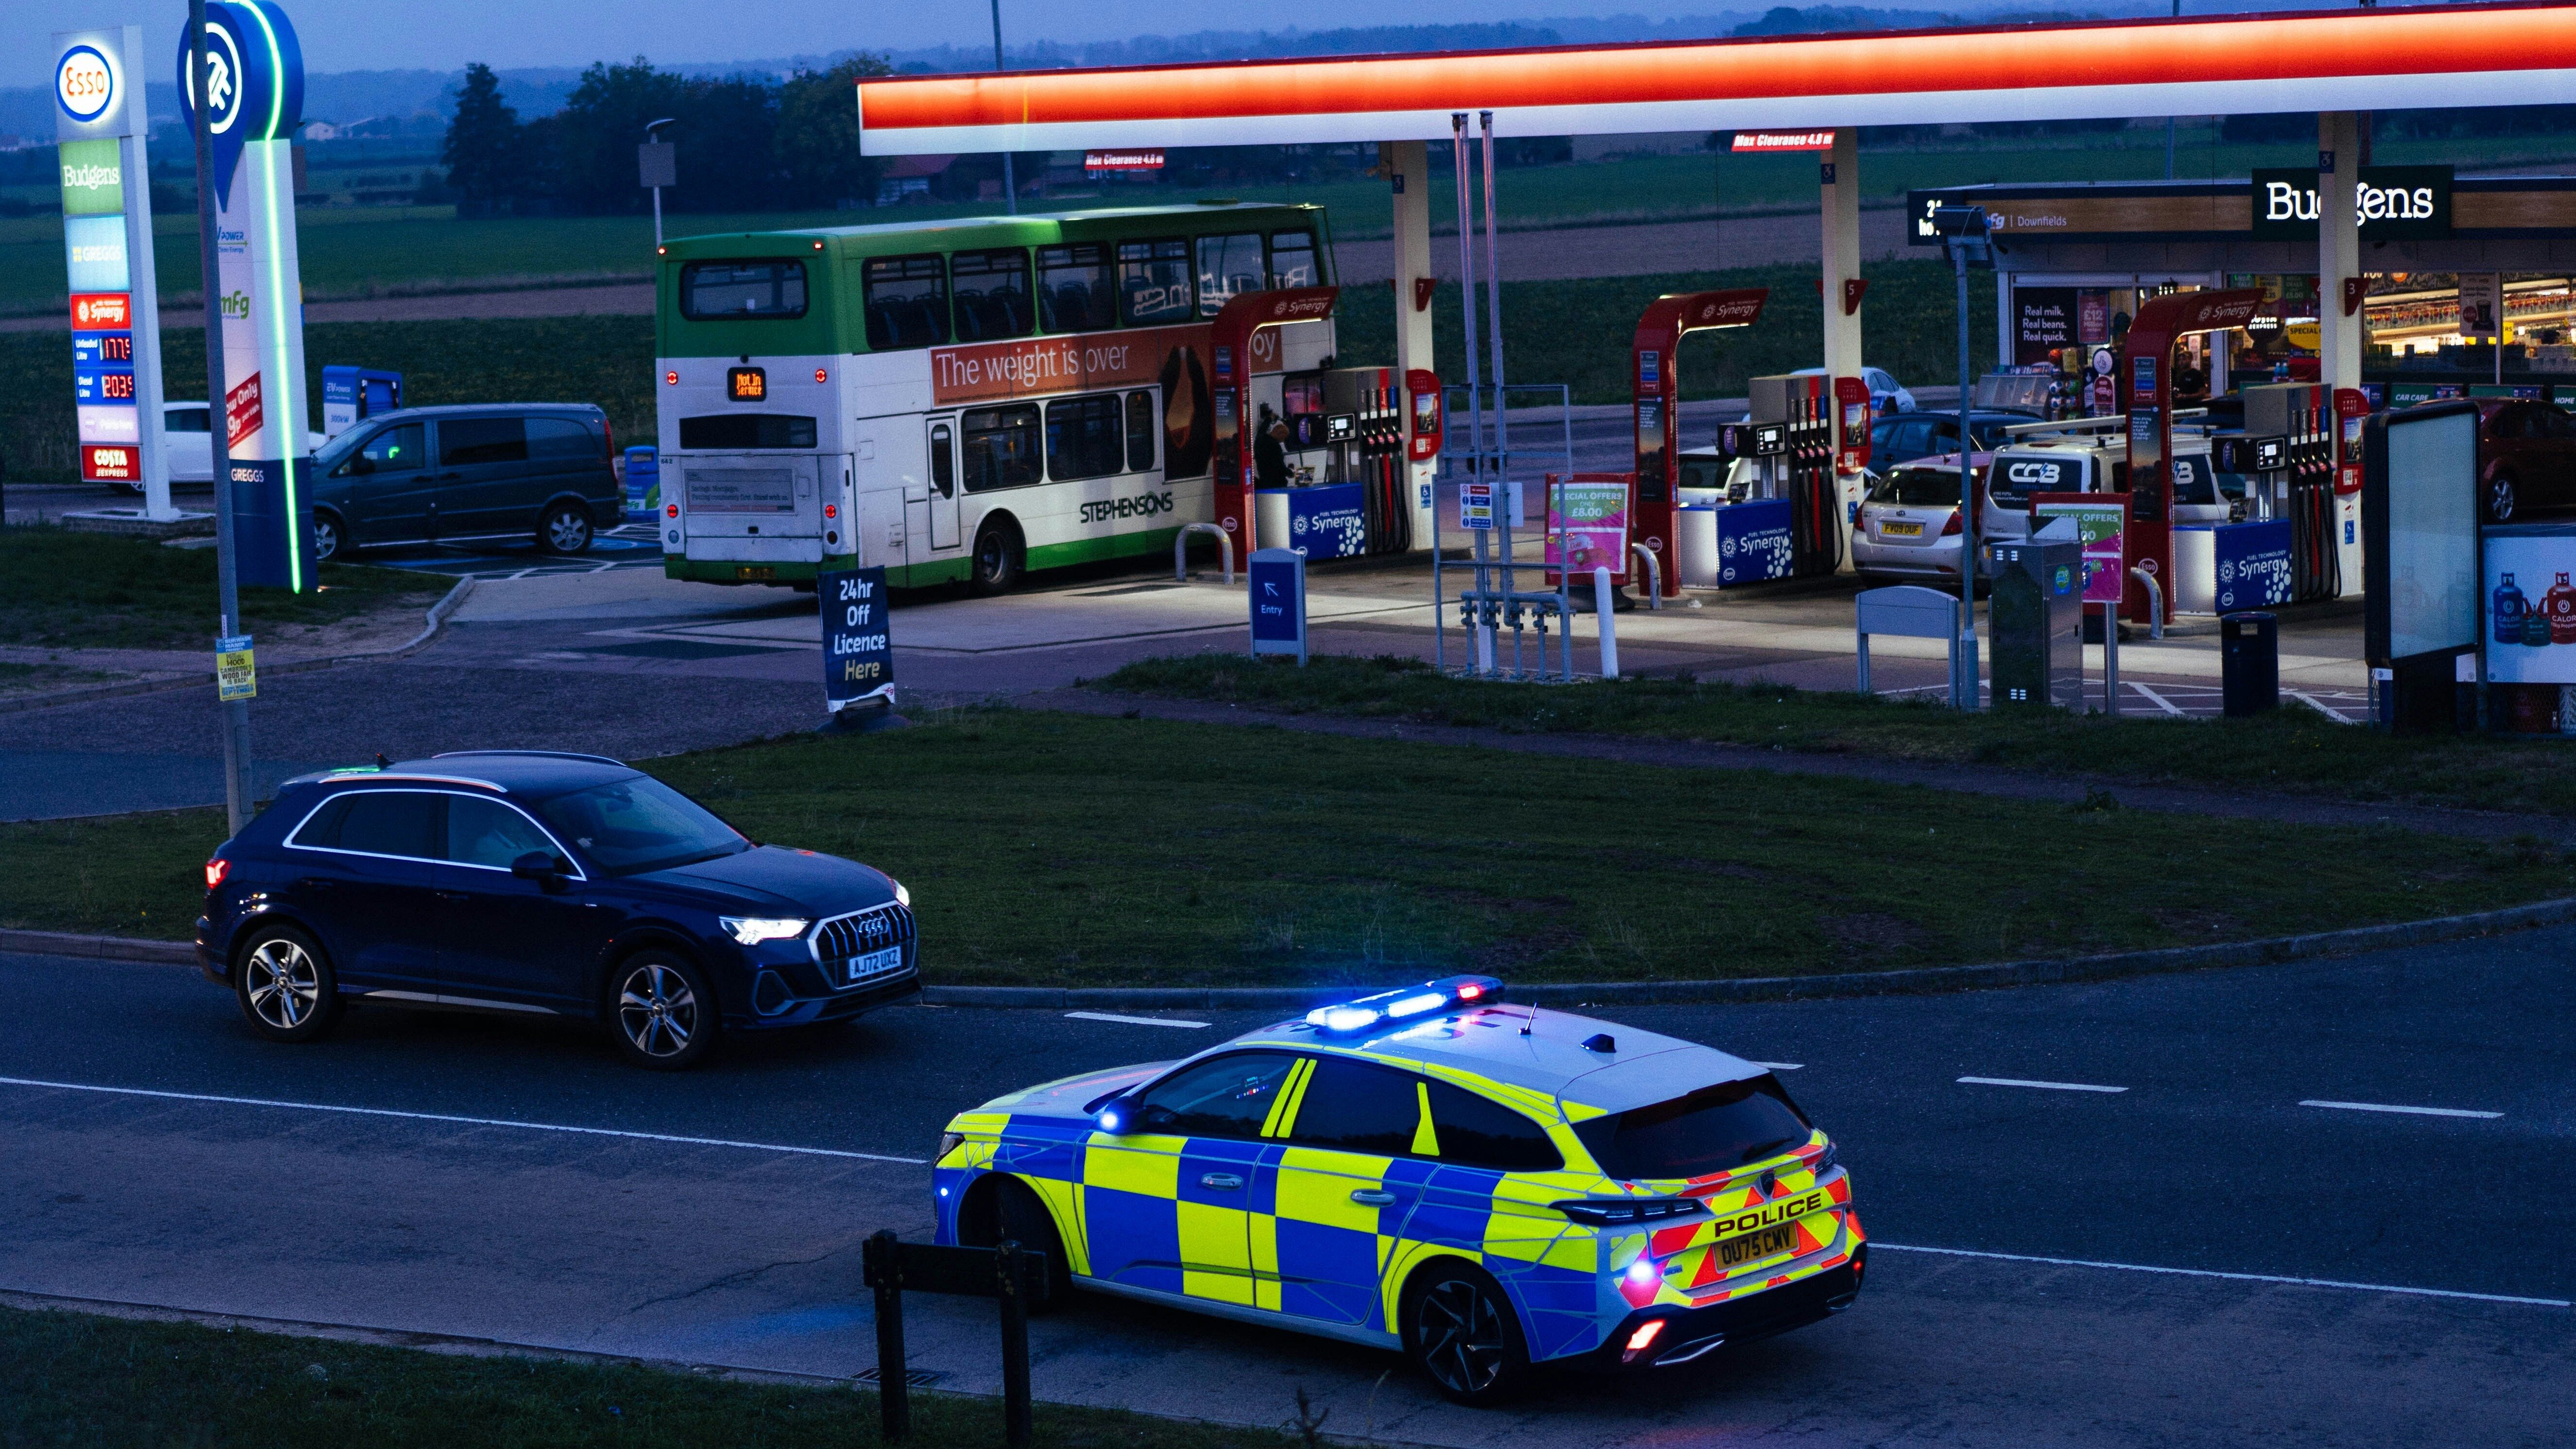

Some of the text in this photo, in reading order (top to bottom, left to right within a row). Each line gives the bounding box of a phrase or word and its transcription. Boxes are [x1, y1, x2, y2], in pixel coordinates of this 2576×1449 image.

[1729, 135, 1754, 147] Max
[1757, 134, 1806, 146] Clearance
[1104, 155, 1142, 165] Clearance
[64, 166, 120, 190] Budgens
[2266, 182, 2434, 226] Buens
[2018, 216, 2067, 227] Downfields
[222, 231, 244, 241] POWER
[83, 246, 120, 262] GREGGS
[1418, 283, 1423, 293] 7
[1848, 285, 1854, 294] 5
[2349, 283, 2355, 294] 3
[90, 302, 123, 322] Synergy
[1288, 301, 1328, 315] Synergy
[1716, 304, 1757, 319] Synergy
[2025, 305, 2064, 316] Real milk.
[2212, 305, 2253, 321] Synergy
[2023, 317, 2067, 329] Real beans.
[2023, 330, 2067, 345] Real quick.
[936, 343, 1129, 387] The weight is over
[737, 373, 761, 386] Not In
[238, 383, 258, 405] Only
[736, 385, 762, 396] Service
[94, 449, 127, 468] COSTA
[101, 468, 128, 477] EXPRESS
[231, 468, 264, 482] GREGGS
[2008, 463, 2060, 484] CCB
[1080, 492, 1173, 523] STEPHENSONS
[1572, 508, 1603, 517] £8.00
[1224, 520, 1235, 529] Esso
[1312, 515, 1359, 534] Synergy
[2083, 514, 2119, 522] OFFERS
[1884, 523, 1903, 532] FV09
[1647, 540, 1660, 549] Esso
[1740, 535, 1787, 555] Synergy
[2258, 550, 2286, 559] TECHNOLOGY
[2239, 558, 2287, 580] Synergy
[840, 579, 873, 600] 24hr
[847, 604, 870, 626] Off
[1261, 605, 1282, 616] Entry
[834, 633, 885, 655] Licence
[845, 659, 880, 680] Here
[854, 948, 898, 974] AJ72 UXZ
[1715, 1192, 1822, 1238] POLICE
[1721, 1226, 1791, 1264] OU75 CMV
